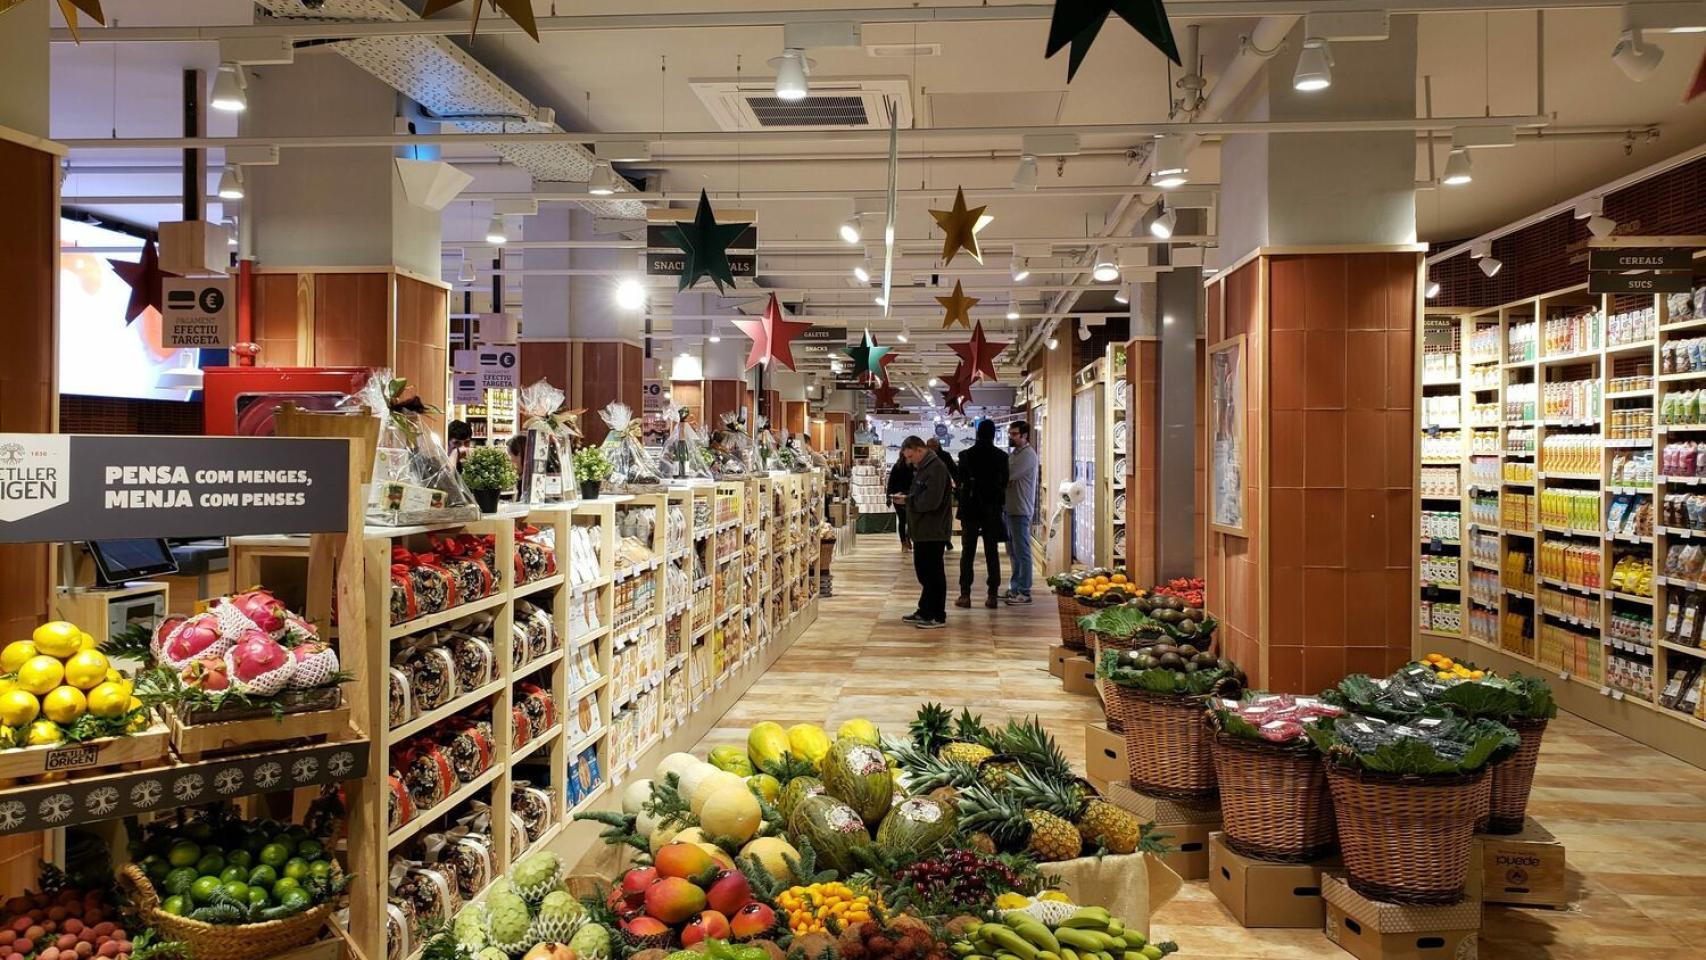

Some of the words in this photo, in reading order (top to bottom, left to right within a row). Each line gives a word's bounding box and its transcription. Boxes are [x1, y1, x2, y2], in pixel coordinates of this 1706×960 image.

[1619, 256, 1664, 265] CEREALS
[729, 262, 750, 271] ALS
[1628, 280, 1653, 289] SUCS
[174, 325, 219, 335] EFECTIU
[171, 336, 220, 345] TARGETA
[105, 465, 190, 485] PENSA
[195, 469, 235, 484] COM
[238, 469, 313, 486] MENGES,
[105, 489, 193, 509] MENJA
[200, 493, 238, 507] COM
[242, 492, 305, 507] PENSES
[50, 753, 95, 768] ORIGEN
